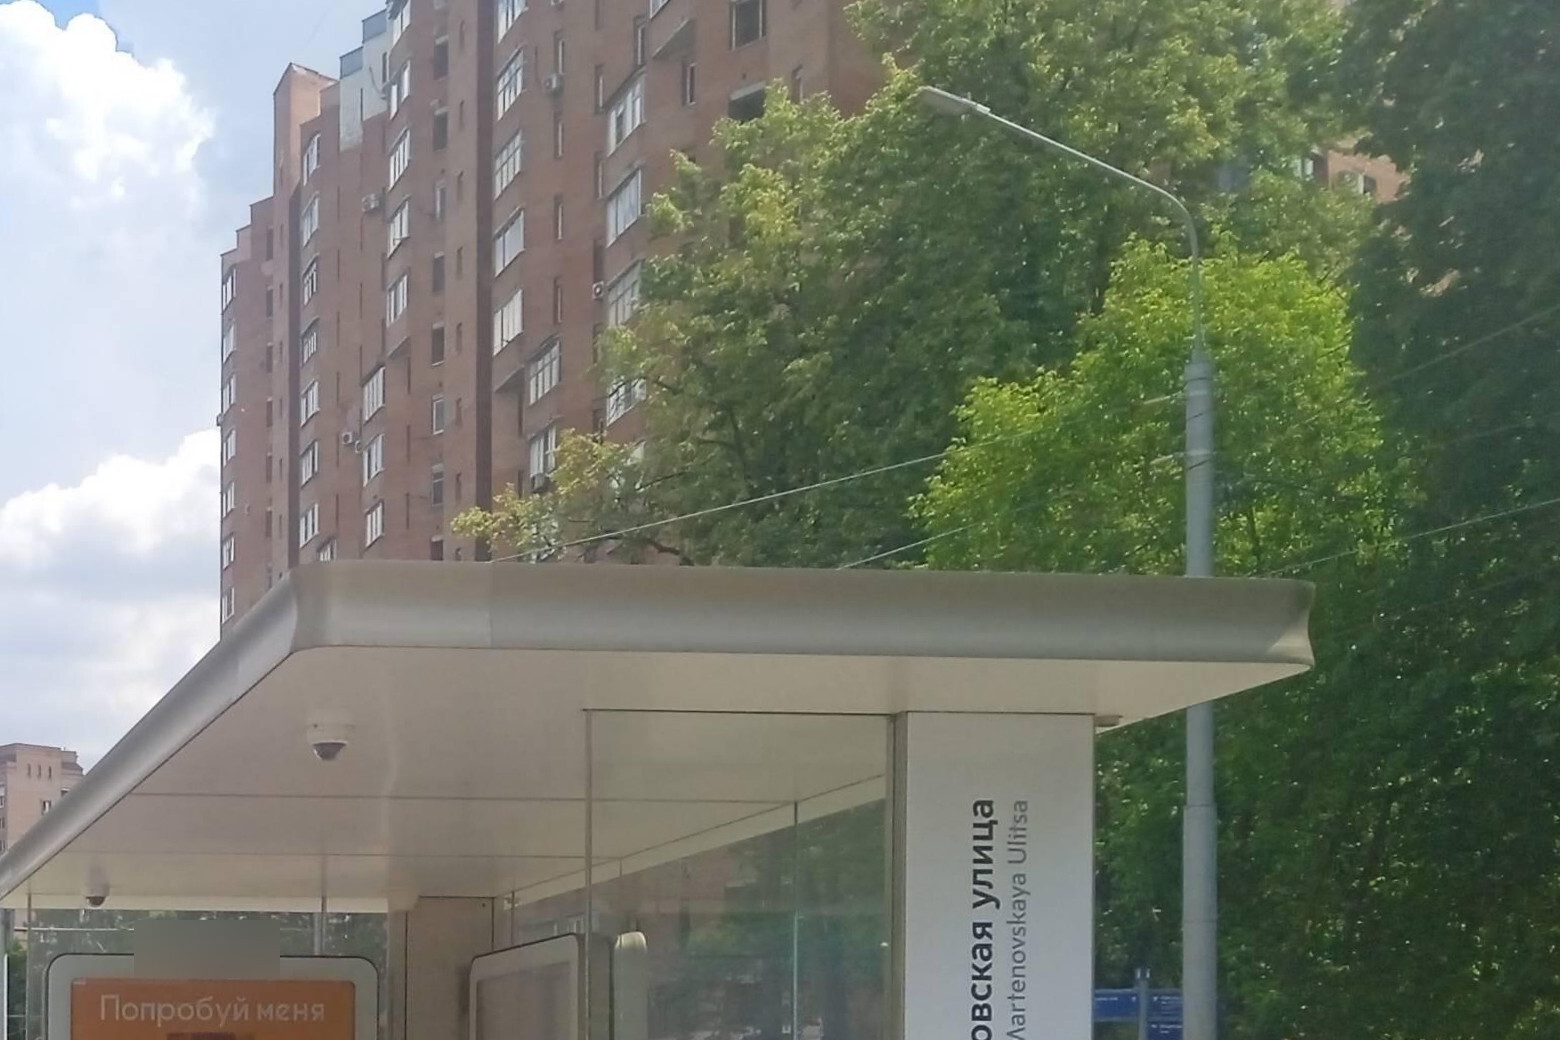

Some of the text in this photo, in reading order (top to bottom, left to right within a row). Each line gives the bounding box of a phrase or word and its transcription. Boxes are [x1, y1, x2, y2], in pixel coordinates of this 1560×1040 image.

[972, 798, 1001, 910] улица
[1006, 800, 1029, 864] Ulitsa
[100, 994, 325, 1028] Попробуй меня
